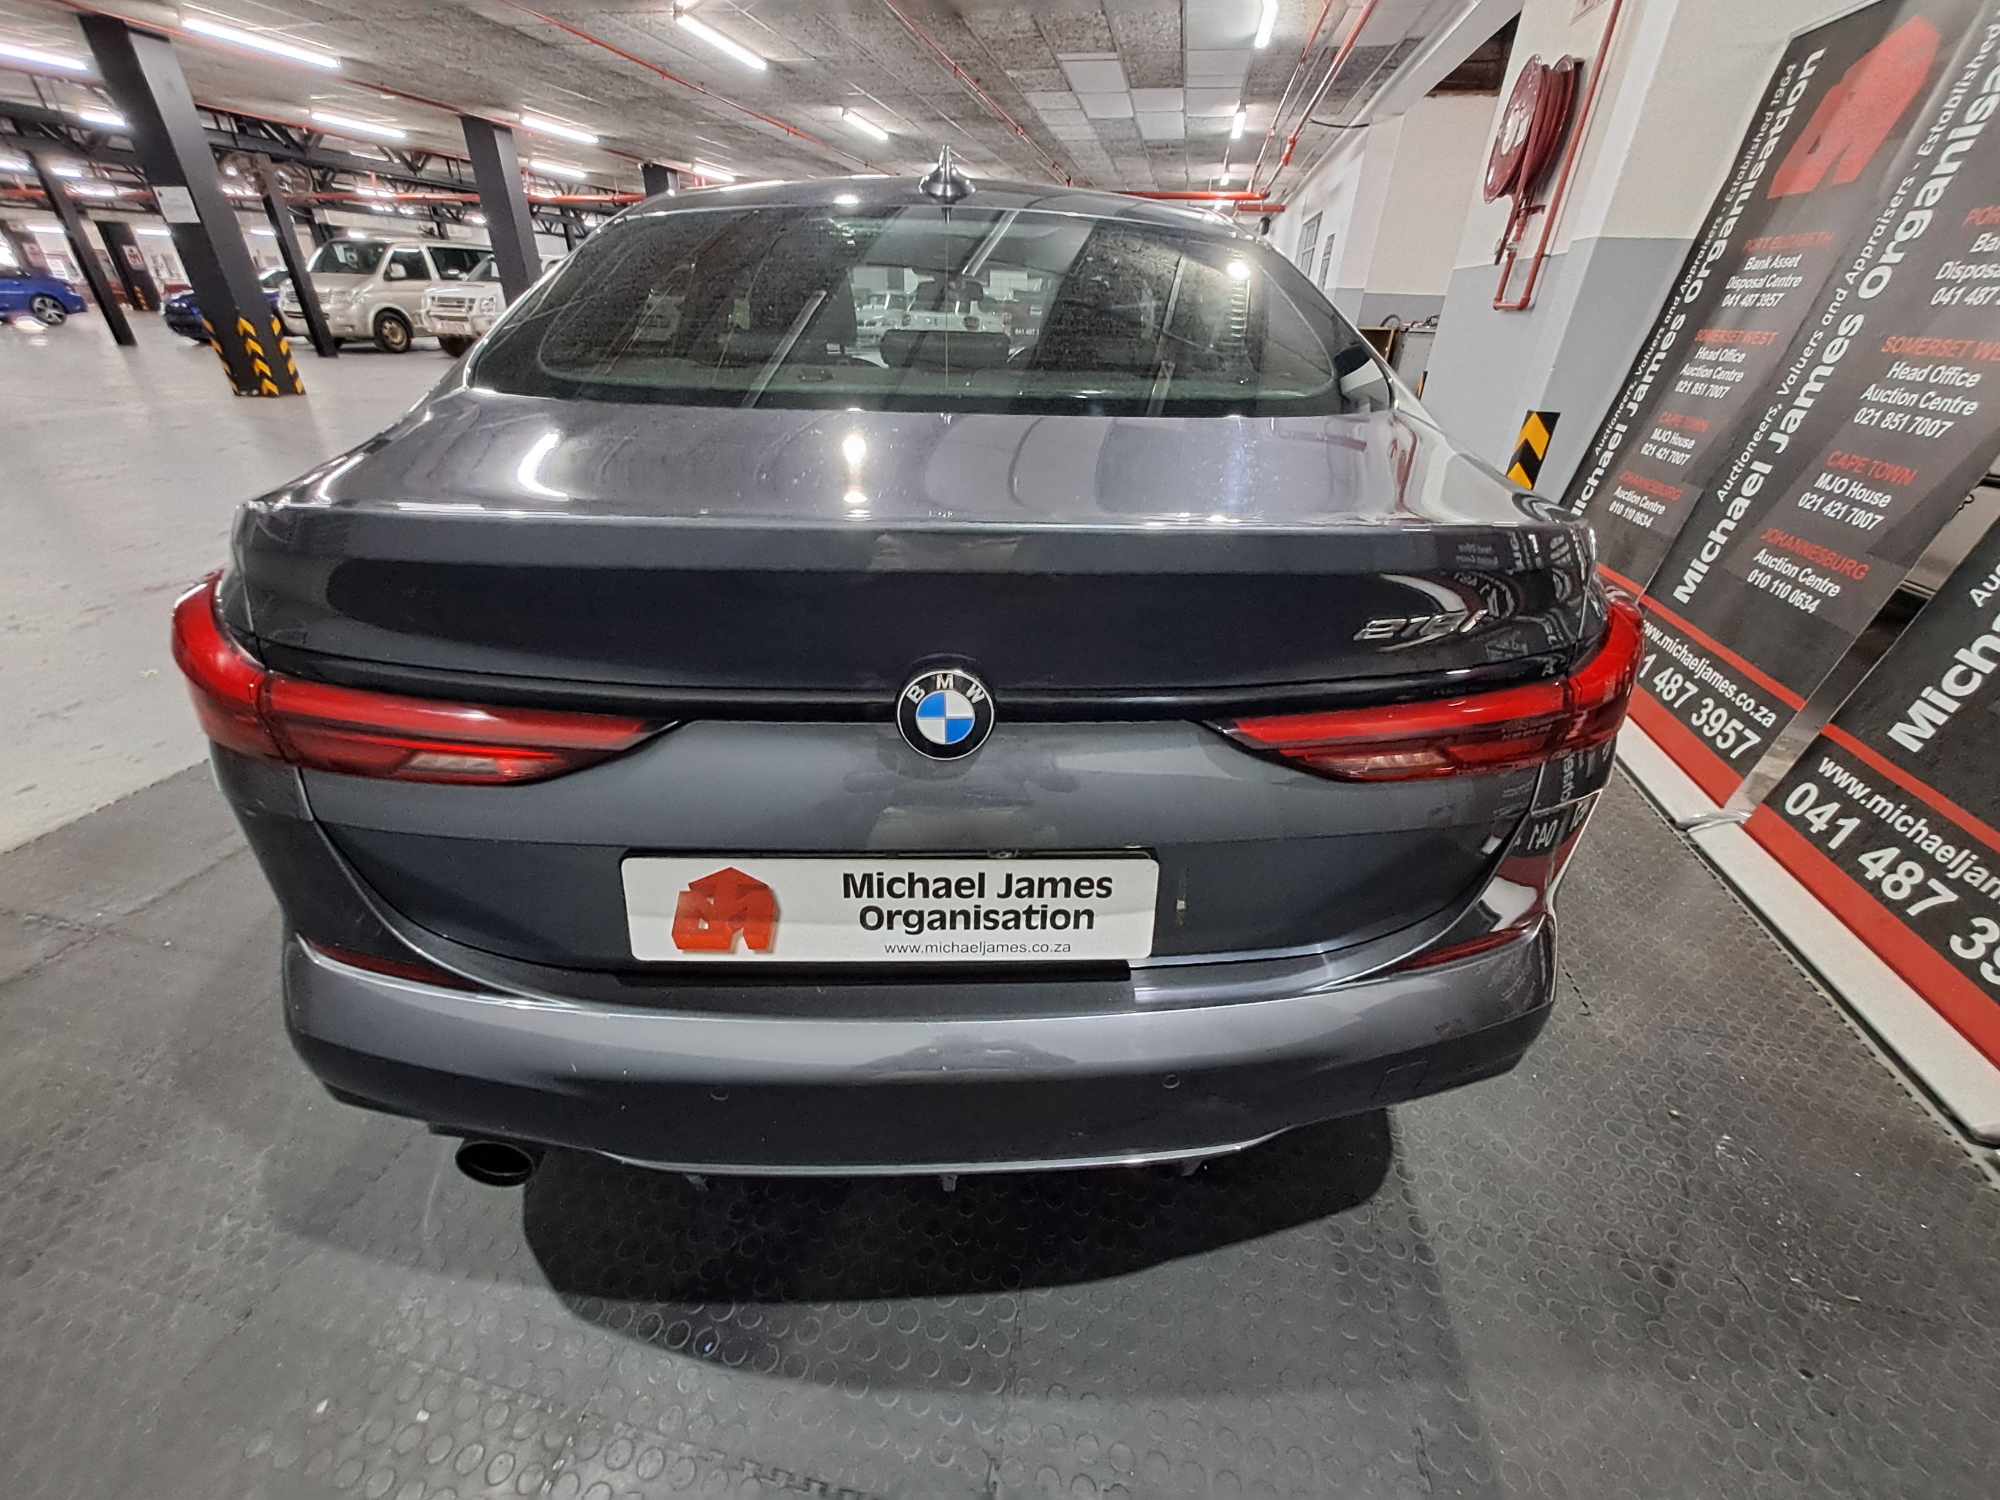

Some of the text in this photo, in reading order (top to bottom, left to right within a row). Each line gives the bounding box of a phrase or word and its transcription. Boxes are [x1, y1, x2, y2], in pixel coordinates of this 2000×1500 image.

[1635, 327, 1665, 376] Valuers
[1664, 295, 1681, 325] and
[1679, 215, 1723, 295] Appraisers
[1724, 112, 1774, 202] Established
[1770, 63, 1797, 107] 1964
[1743, 254, 1802, 272] Bank Asset
[1570, 47, 1827, 516] ichael James Organisation
[1725, 273, 1803, 291] Disposal Centre
[1931, 286, 1967, 306] 041
[1963, 286, 2000, 306] 487
[1716, 403, 1782, 502] Auctioneers,
[1776, 329, 1825, 396] Valuers
[1822, 287, 1850, 326] and
[1845, 174, 1916, 286] Appraisers
[1881, 336, 1974, 358] SOMERSET
[1694, 347, 1746, 363] Head Office
[1680, 363, 1744, 382] Auction Centre
[1887, 360, 1982, 388] Head Office
[1675, 380, 1694, 393] 021
[1705, 384, 1732, 399] 7007
[1860, 383, 1979, 416] Auction Centre
[1650, 428, 1696, 449] MJO House
[1853, 407, 1954, 438] 021 851 7007
[1673, 460, 1774, 604] Michael
[1767, 313, 1865, 454] James
[1824, 449, 1917, 486] CAPE TOWN
[1614, 486, 1666, 515] Auction Centre
[1813, 472, 1893, 508] MJO House
[1797, 492, 1885, 530] 021 421 7007
[1760, 527, 1871, 581] JOHANNESBURG
[1753, 548, 1842, 597] Auction Centre
[1747, 569, 1821, 614] 010 110 0634
[906, 673, 985, 704] BMW
[1642, 619, 1777, 729] ww.michaeljames.co.za
[1887, 612, 2000, 753] Mich
[1653, 667, 1699, 709] 487
[1690, 697, 1761, 759] 3957
[1784, 781, 1861, 850] 041
[1857, 846, 1959, 917] 487
[843, 872, 1113, 899] Michael James
[859, 904, 1095, 935] Organisation
[884, 941, 1072, 956] www.michaeljames.co.za
